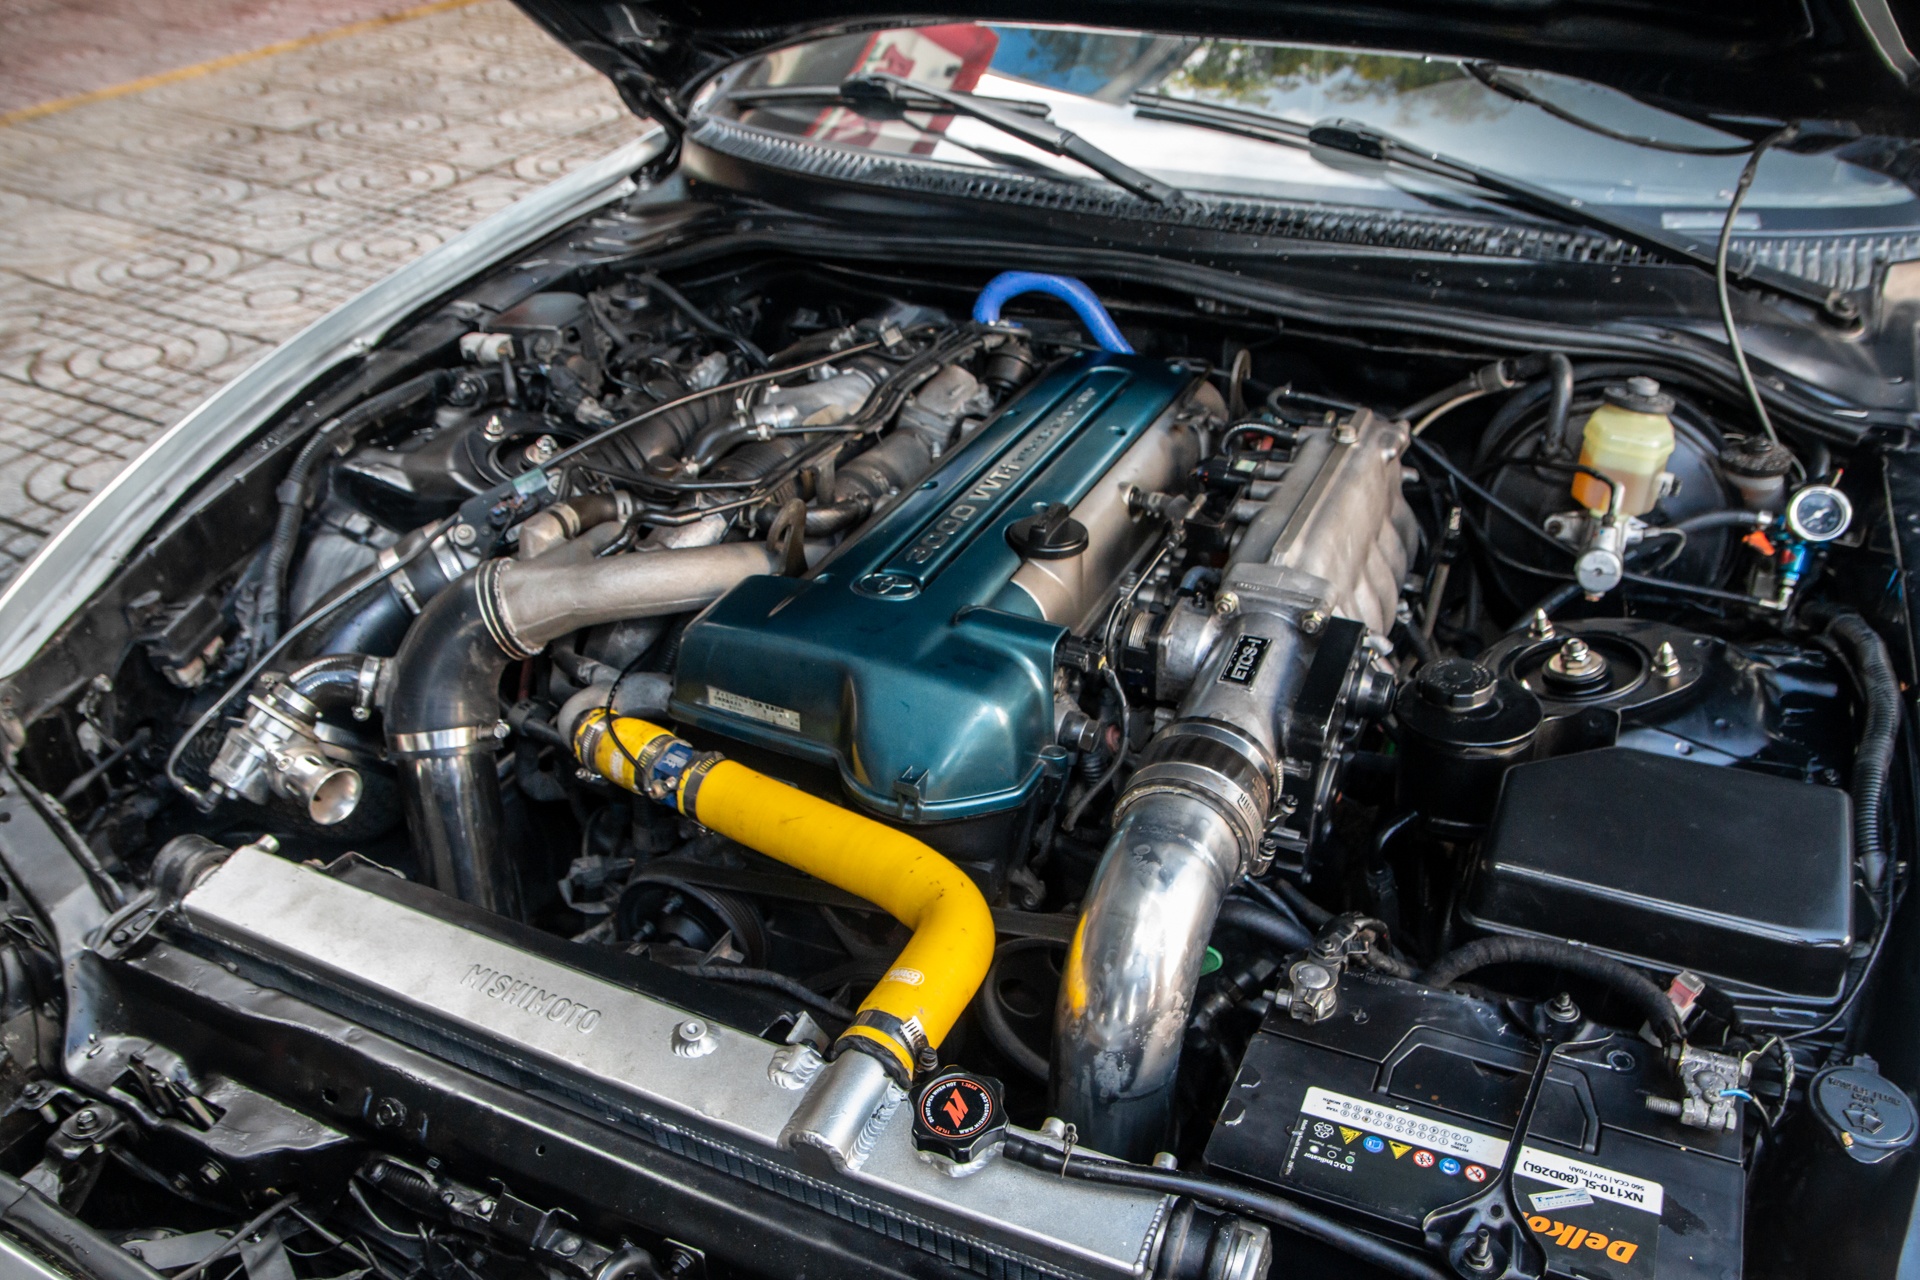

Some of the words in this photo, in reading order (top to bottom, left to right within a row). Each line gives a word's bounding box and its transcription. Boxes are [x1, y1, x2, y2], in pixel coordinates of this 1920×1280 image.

[905, 504, 977, 564] 3000
[968, 463, 1020, 501] VVT-i
[460, 964, 602, 1034] MISHIMOTO
[926, 1095, 934, 1106] OPEN
[1304, 1152, 1332, 1166] Indicator
[1334, 1161, 1353, 1172] S.O.C
[1523, 1161, 1578, 1184] (80D26L)
[1568, 1166, 1588, 1175] 70Ah
[1614, 1178, 1630, 1186] CCA
[1631, 1183, 1644, 1191] 560
[1582, 1178, 1644, 1203] NX110-5L
[1522, 1212, 1638, 1264] Delko
